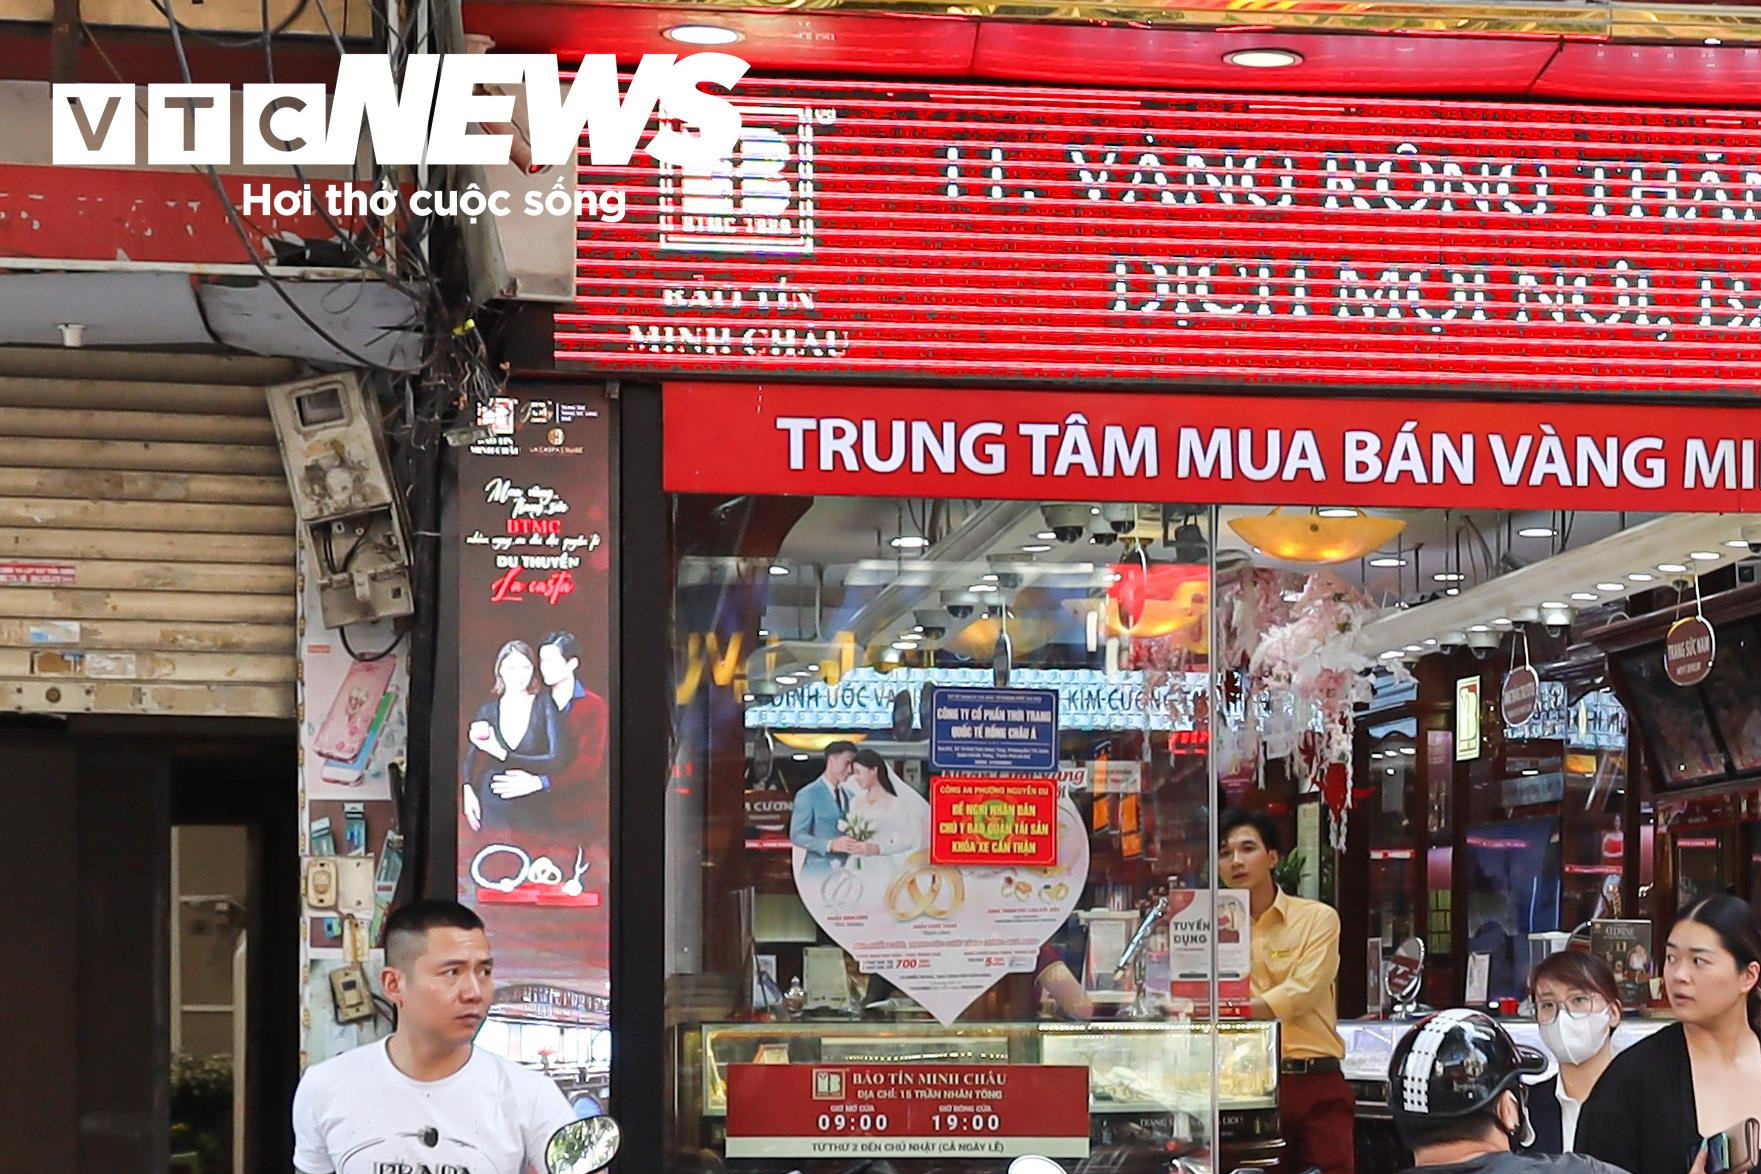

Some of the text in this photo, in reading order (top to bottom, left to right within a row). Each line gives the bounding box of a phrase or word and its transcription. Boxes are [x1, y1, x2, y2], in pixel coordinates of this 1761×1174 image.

[775, 416, 1004, 475] TRUNG
[1018, 412, 1158, 478] TÂM
[1177, 425, 1326, 482] MUA
[1343, 420, 1474, 485] BÁN
[1488, 423, 1666, 488] VÀNG
[496, 555, 518, 569] DU
[853, 1070, 1007, 1086] BẢO TÍN MINH CHÂU
[914, 1087, 941, 1099] TRẦN
[943, 1088, 972, 1099] NHÂN
[818, 1114, 888, 1131] 09:00
[931, 1114, 1000, 1131] 19:00
